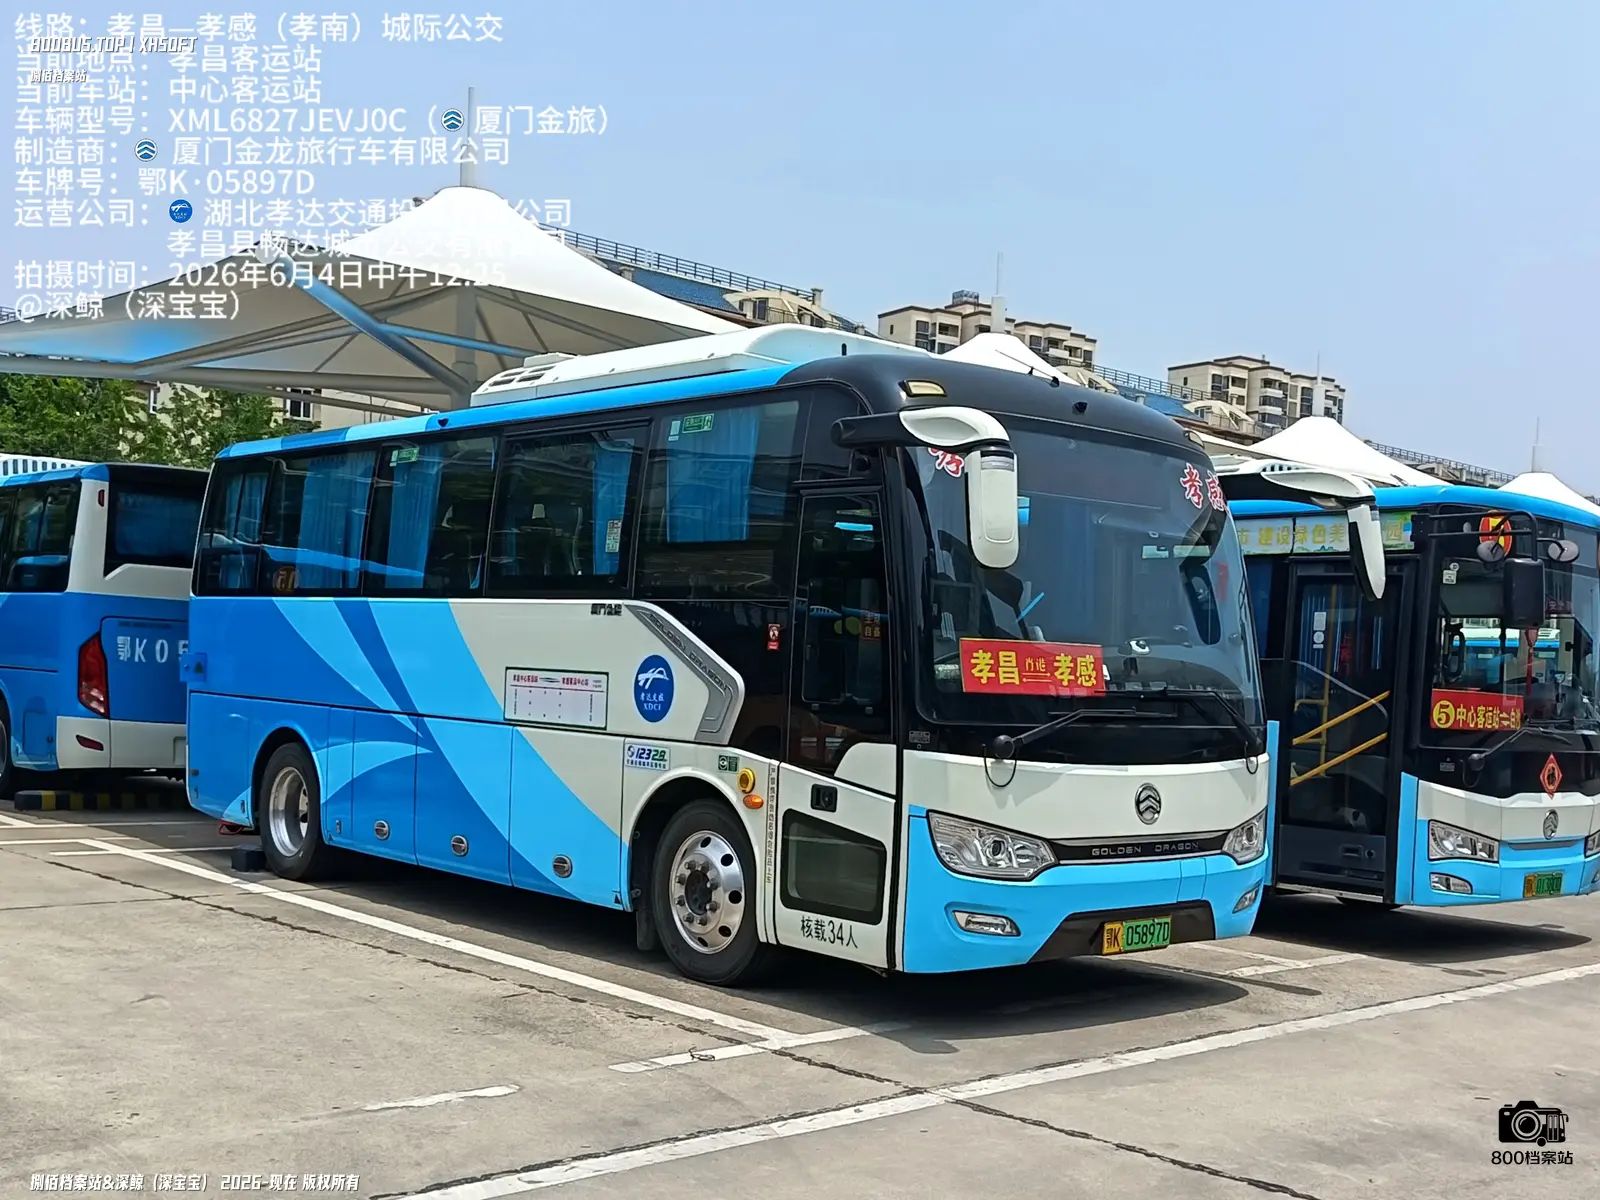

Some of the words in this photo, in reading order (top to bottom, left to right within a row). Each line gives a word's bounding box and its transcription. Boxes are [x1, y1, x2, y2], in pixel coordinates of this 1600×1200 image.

[970, 649, 1020, 685] 孝昌
[1053, 652, 1097, 687] 孝感
[1436, 703, 1452, 726] 5
[1456, 703, 1500, 729] 中心客运站
[635, 747, 667, 761] 12328
[1091, 846, 1142, 856] GOLDEN
[1154, 841, 1199, 852] DRAGON
[800, 915, 858, 949] 核载34人
